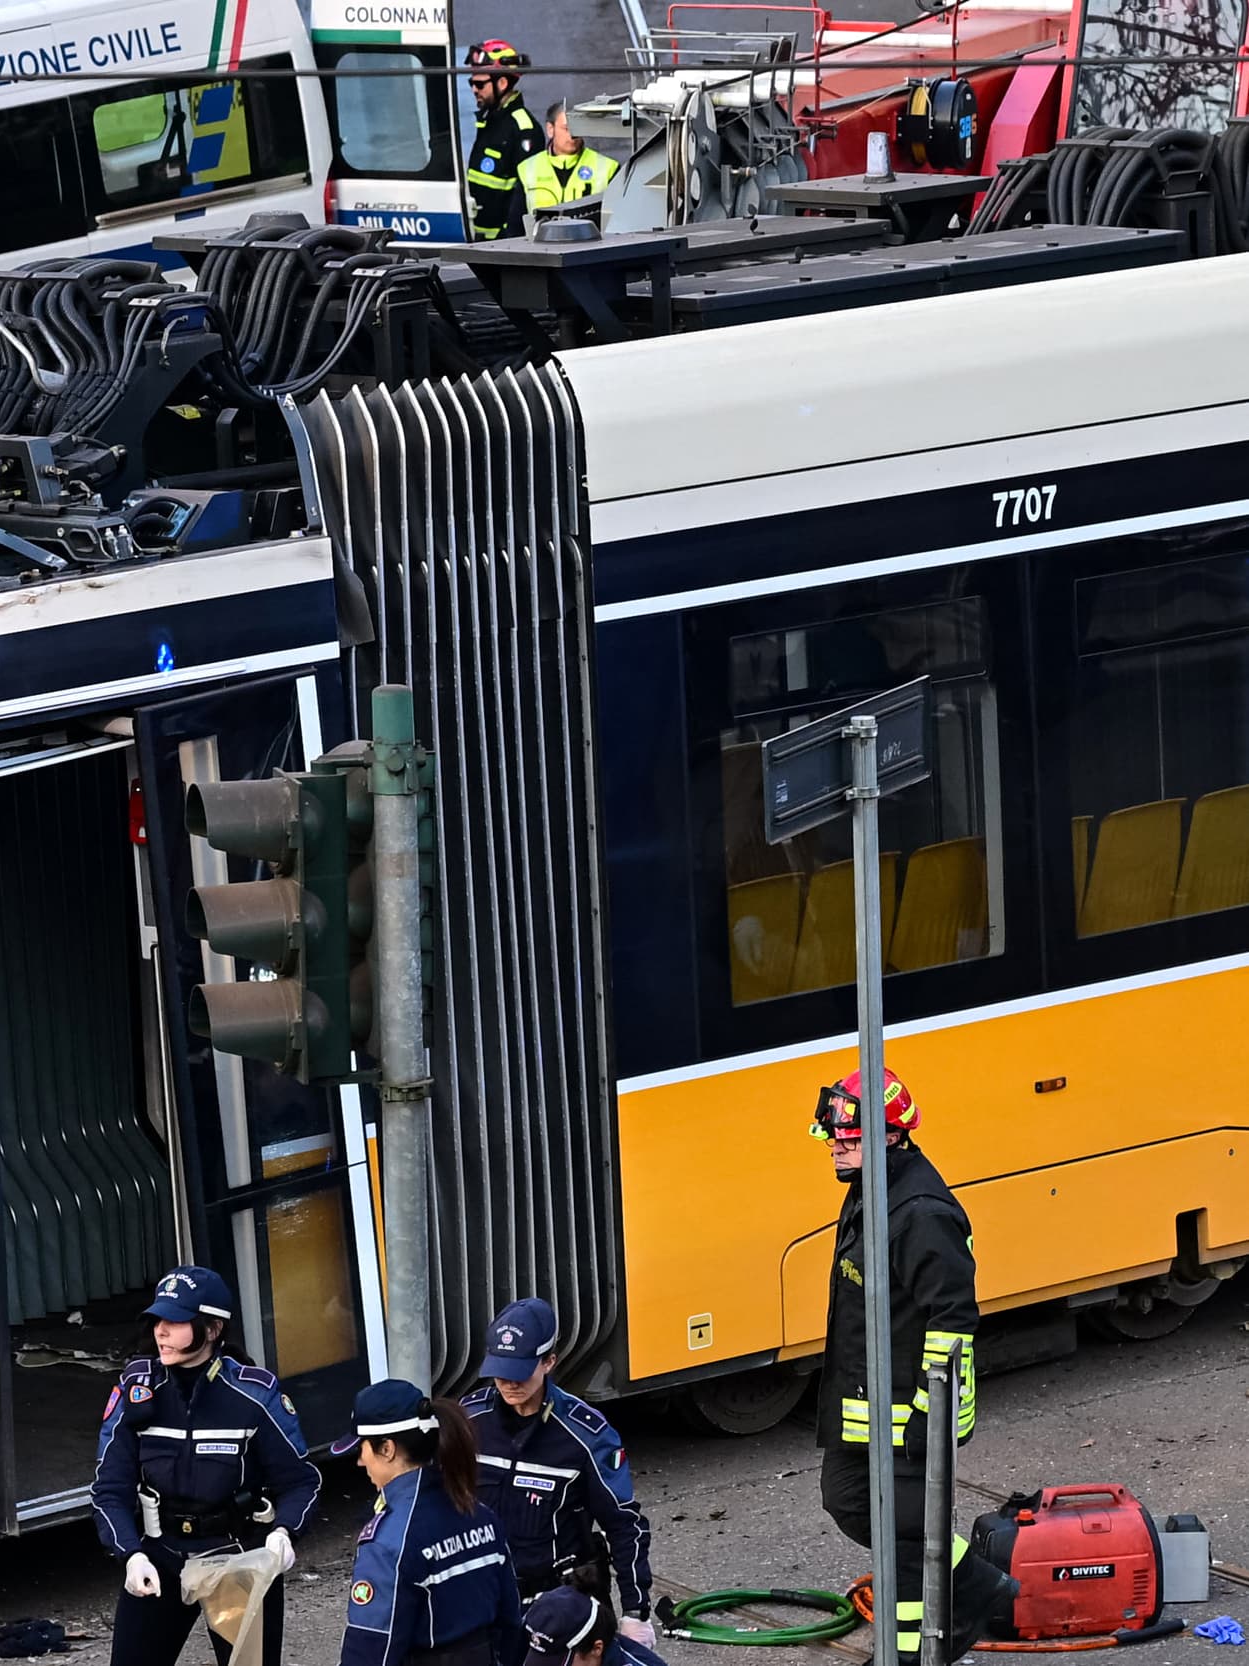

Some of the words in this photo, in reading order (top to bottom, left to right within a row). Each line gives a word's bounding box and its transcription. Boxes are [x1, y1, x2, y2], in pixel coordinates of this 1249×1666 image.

[345, 7, 428, 23] COLONNA
[88, 22, 182, 67] CIVILE
[358, 216, 431, 236] MILANO
[992, 484, 1057, 528] 7707
[1072, 1566, 1110, 1576] DIVITEC
